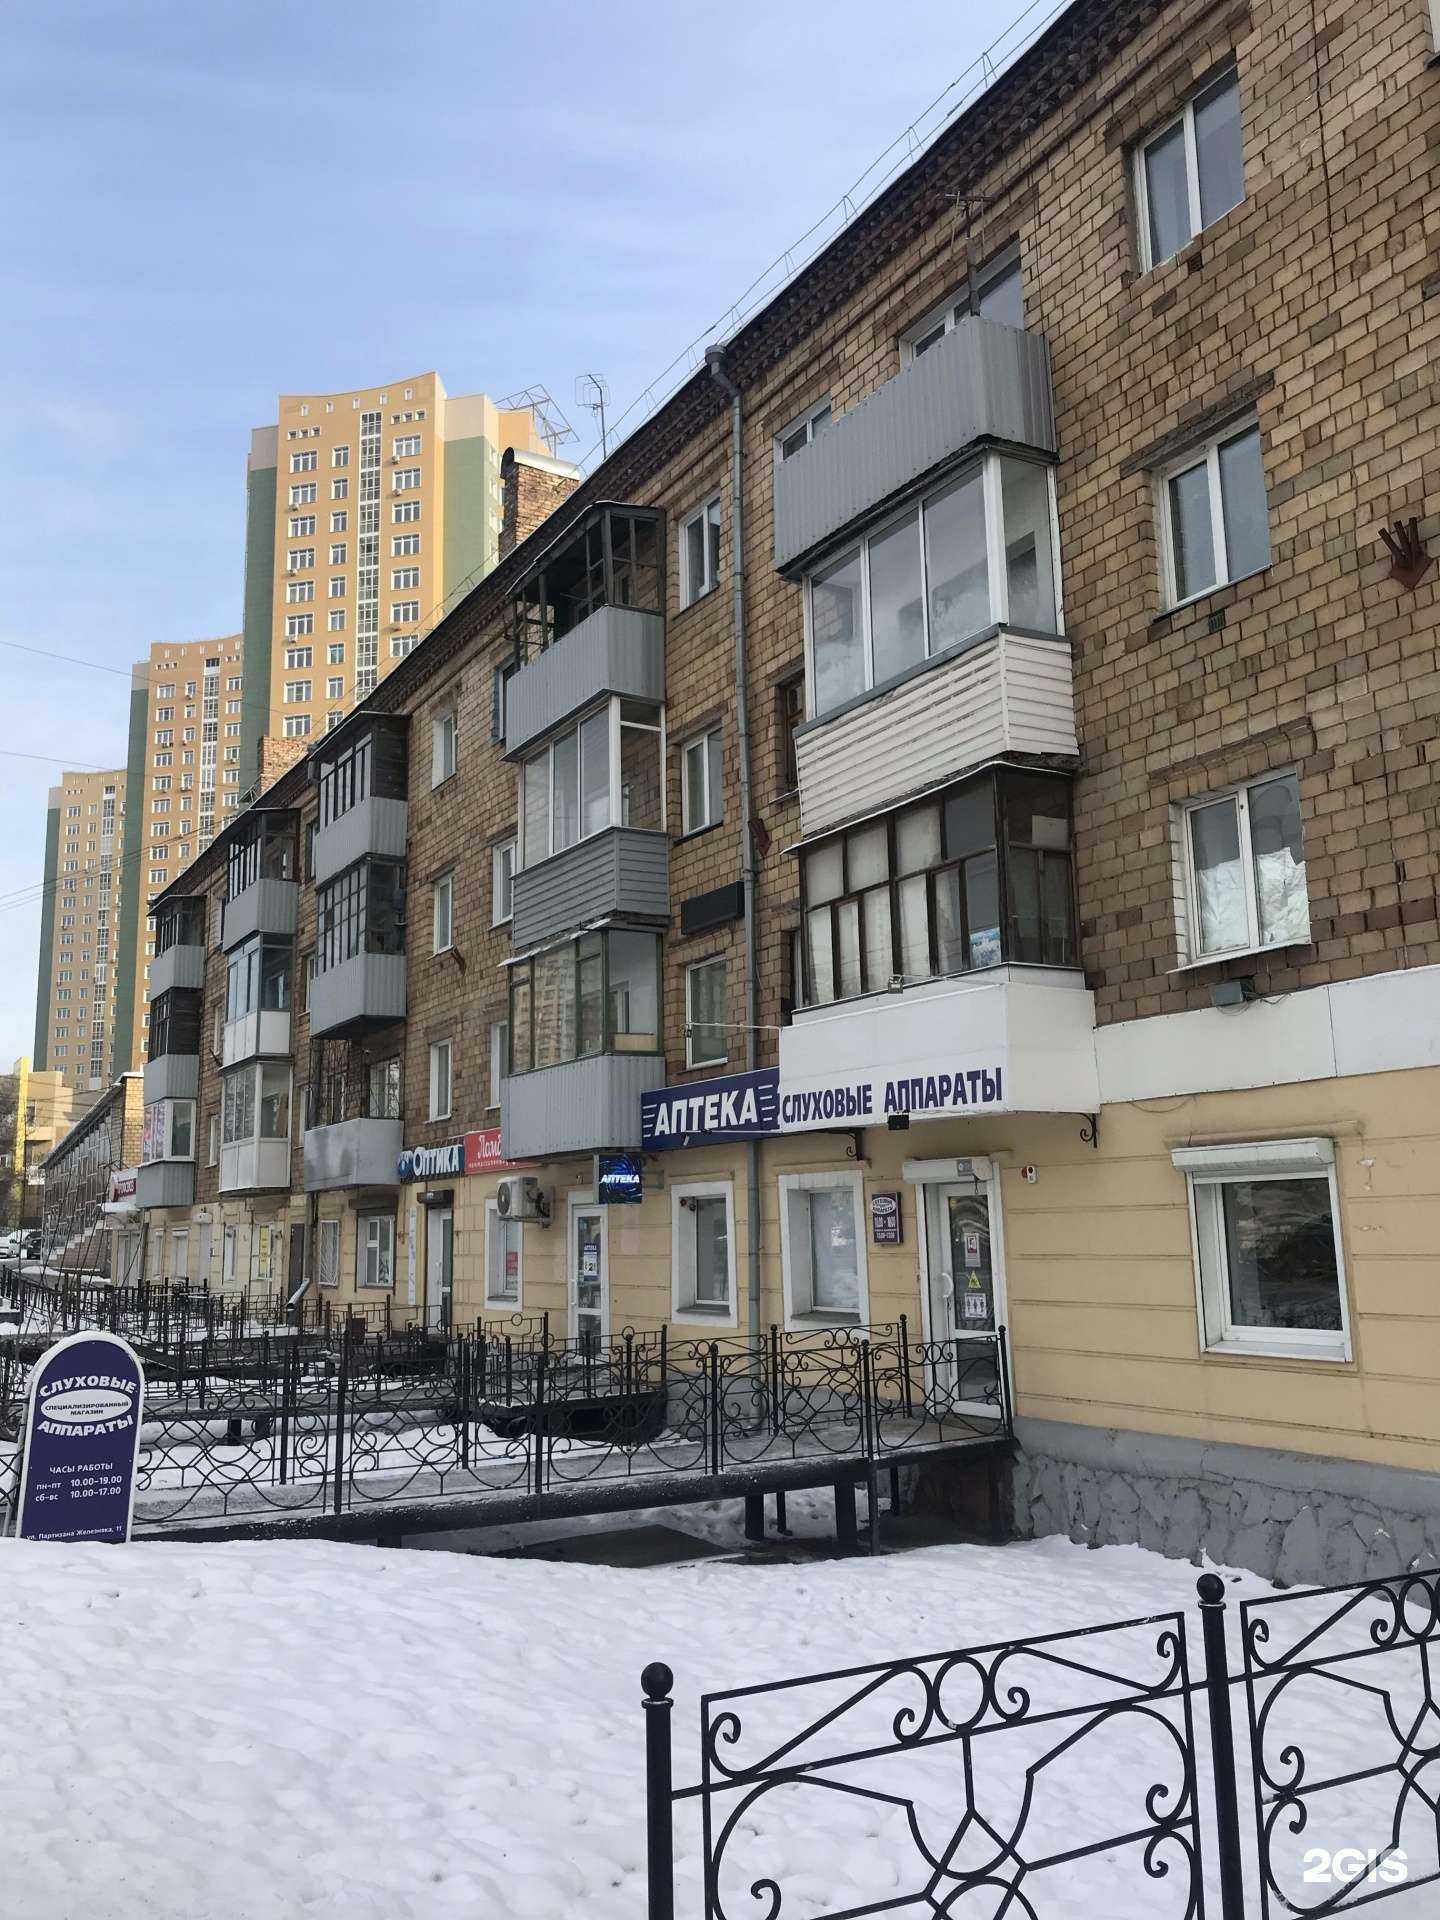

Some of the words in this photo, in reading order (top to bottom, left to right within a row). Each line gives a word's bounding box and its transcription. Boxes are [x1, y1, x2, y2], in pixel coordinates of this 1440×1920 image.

[782, 1084, 872, 1123] СЛУХОВЫЕ
[884, 1067, 1003, 1113] АППАРАТЫ
[654, 1087, 758, 1137] АПТЕКА
[599, 1174, 640, 1184] АПТЕКА
[39, 1375, 138, 1398] СЛУХОВЫЕ
[45, 1401, 129, 1411] СПЕЦИАЛИЗИРОВАННЫЙ
[37, 1415, 134, 1437] АППАРАТЫ
[49, 1465, 75, 1474] ЧАСЫ
[77, 1462, 113, 1472] РАБОТЫ
[70, 1475, 122, 1487] 10.00-19.00
[70, 1487, 122, 1499] 10.00-17.00
[38, 1531, 75, 1540] Партизана
